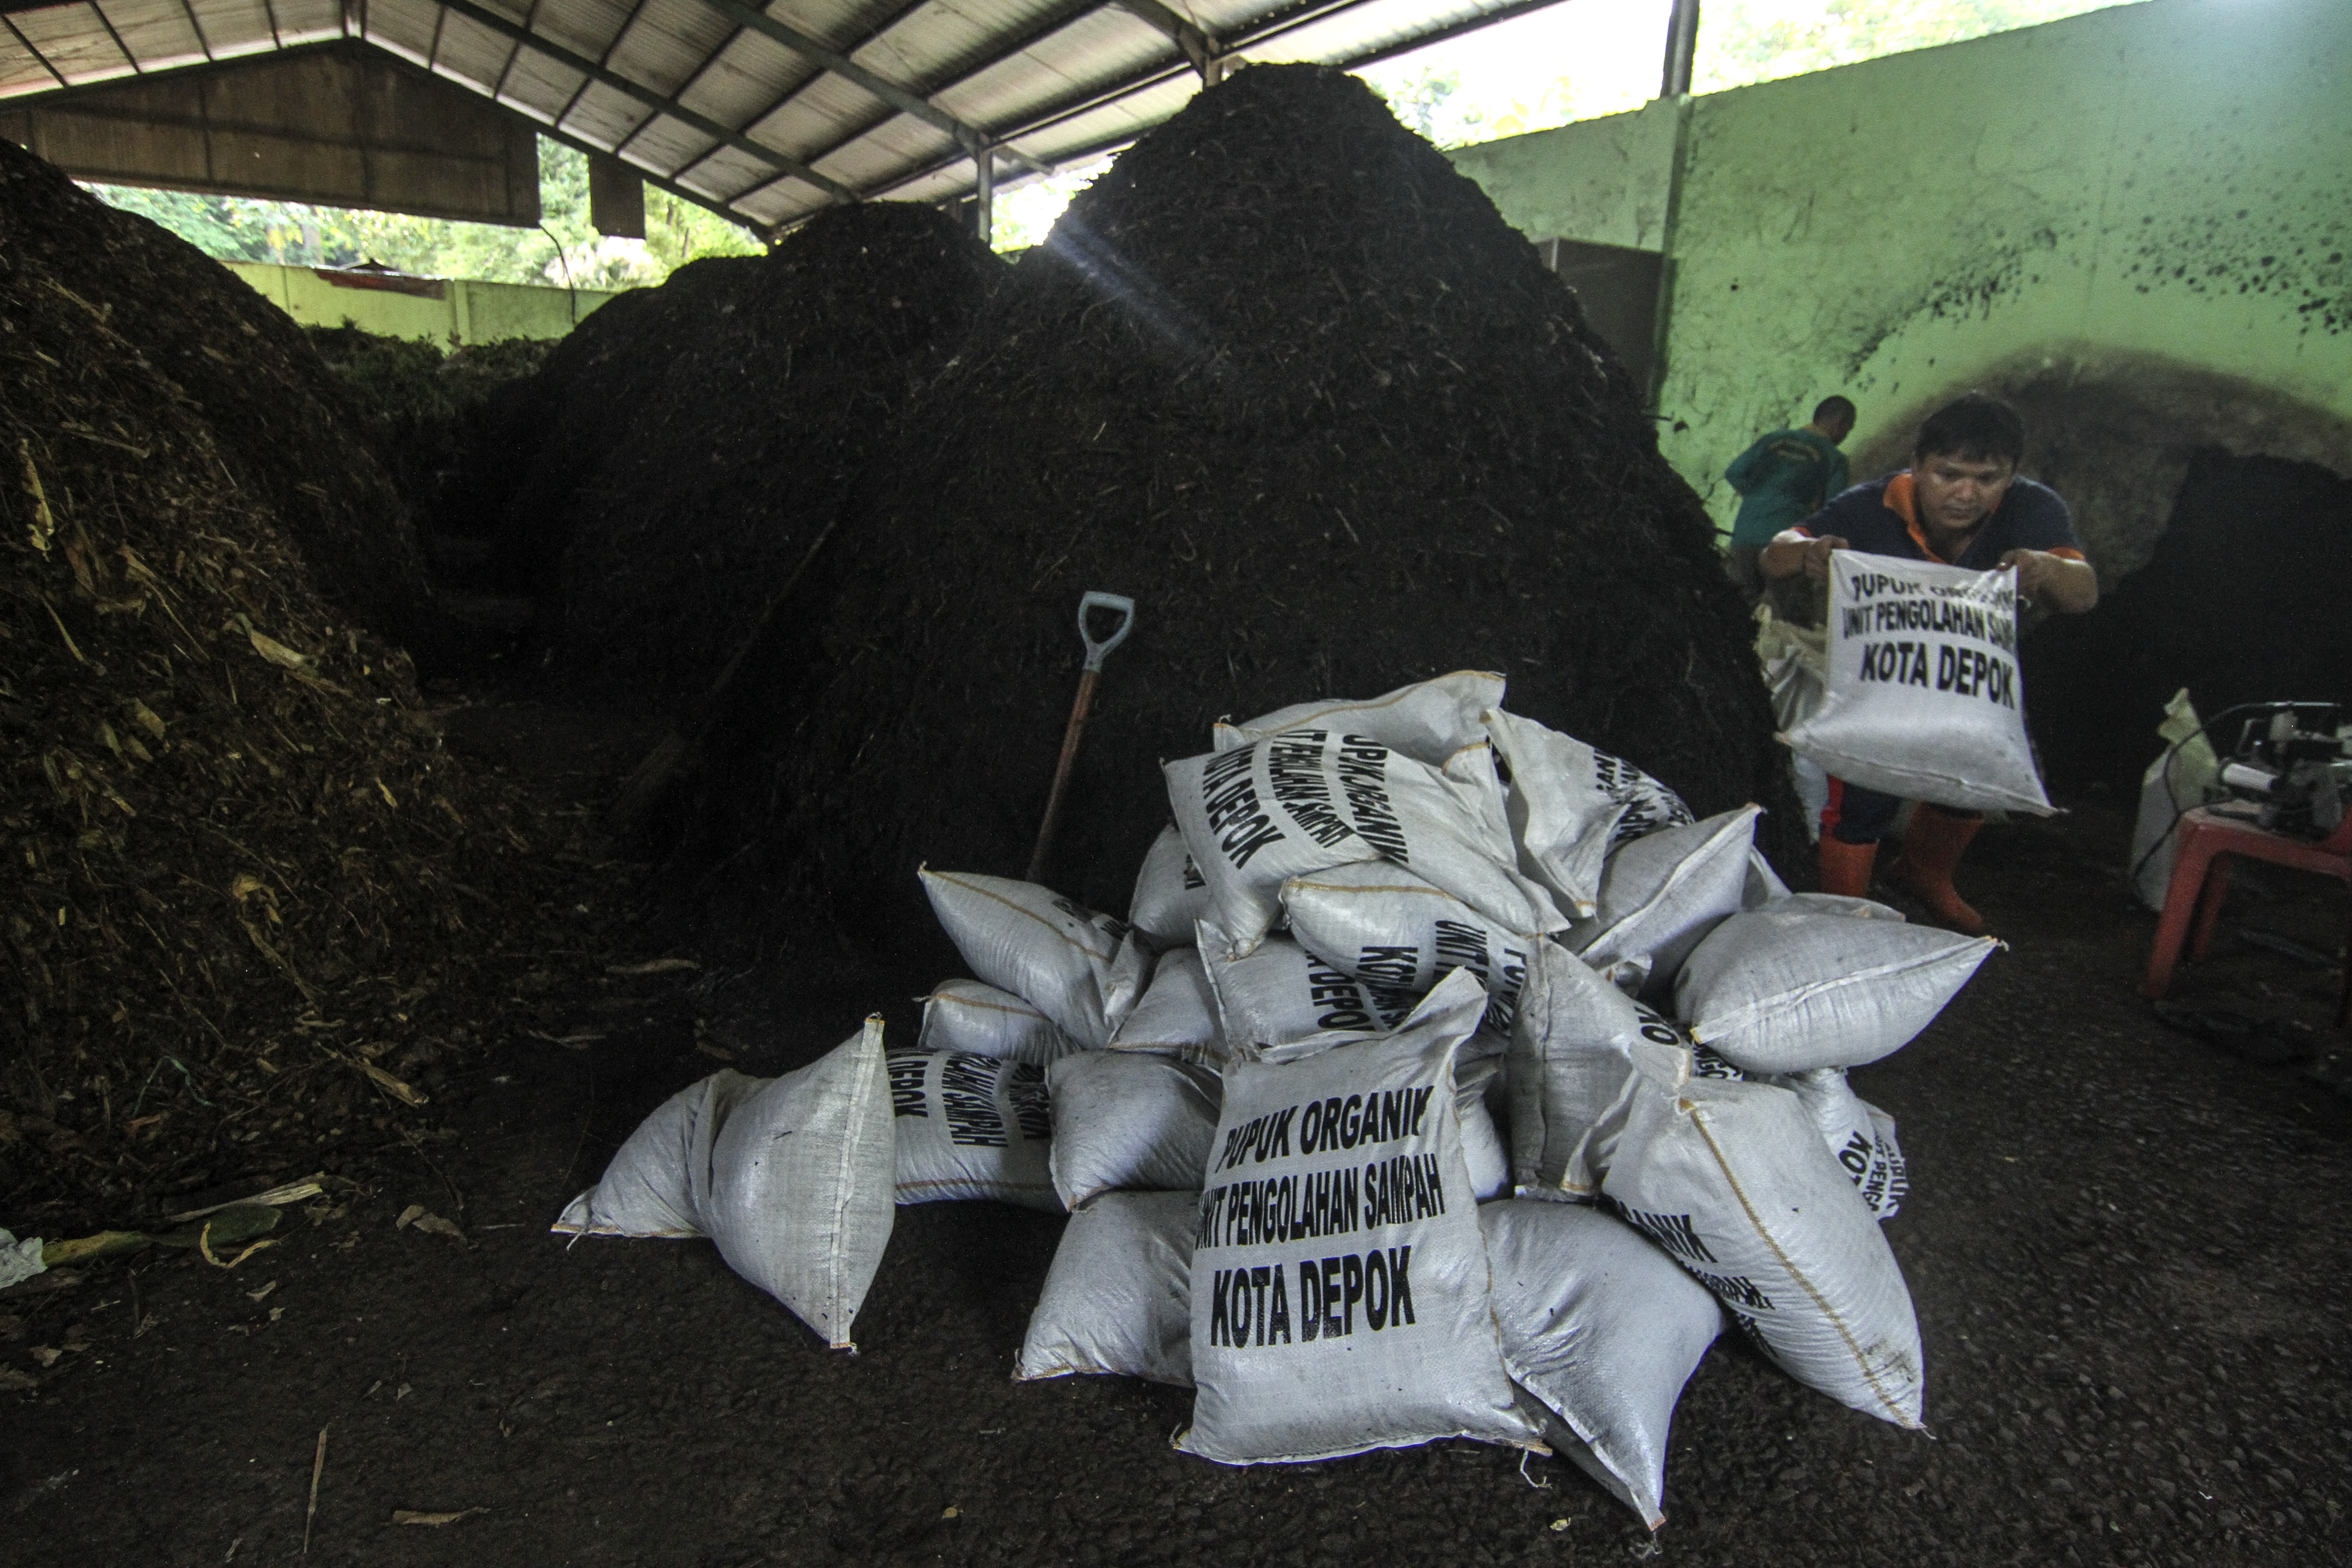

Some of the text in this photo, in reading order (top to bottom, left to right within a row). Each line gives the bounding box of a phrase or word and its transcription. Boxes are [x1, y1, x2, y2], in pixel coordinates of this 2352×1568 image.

[1876, 599, 1986, 641] PENGOLAHAN
[1859, 641, 2014, 710] KOTA DEPOK
[1206, 777, 1287, 871] DEPOK
[1434, 920, 1490, 966] UNIT
[1215, 1085, 1435, 1174] PUPUK ORGANIK
[1838, 1130, 1874, 1188] KO
[1227, 1167, 1359, 1246] PENGOLAHAN
[1364, 1153, 1446, 1230] SAMPAH
[1211, 1245, 1415, 1349] KOTA DEPOK
